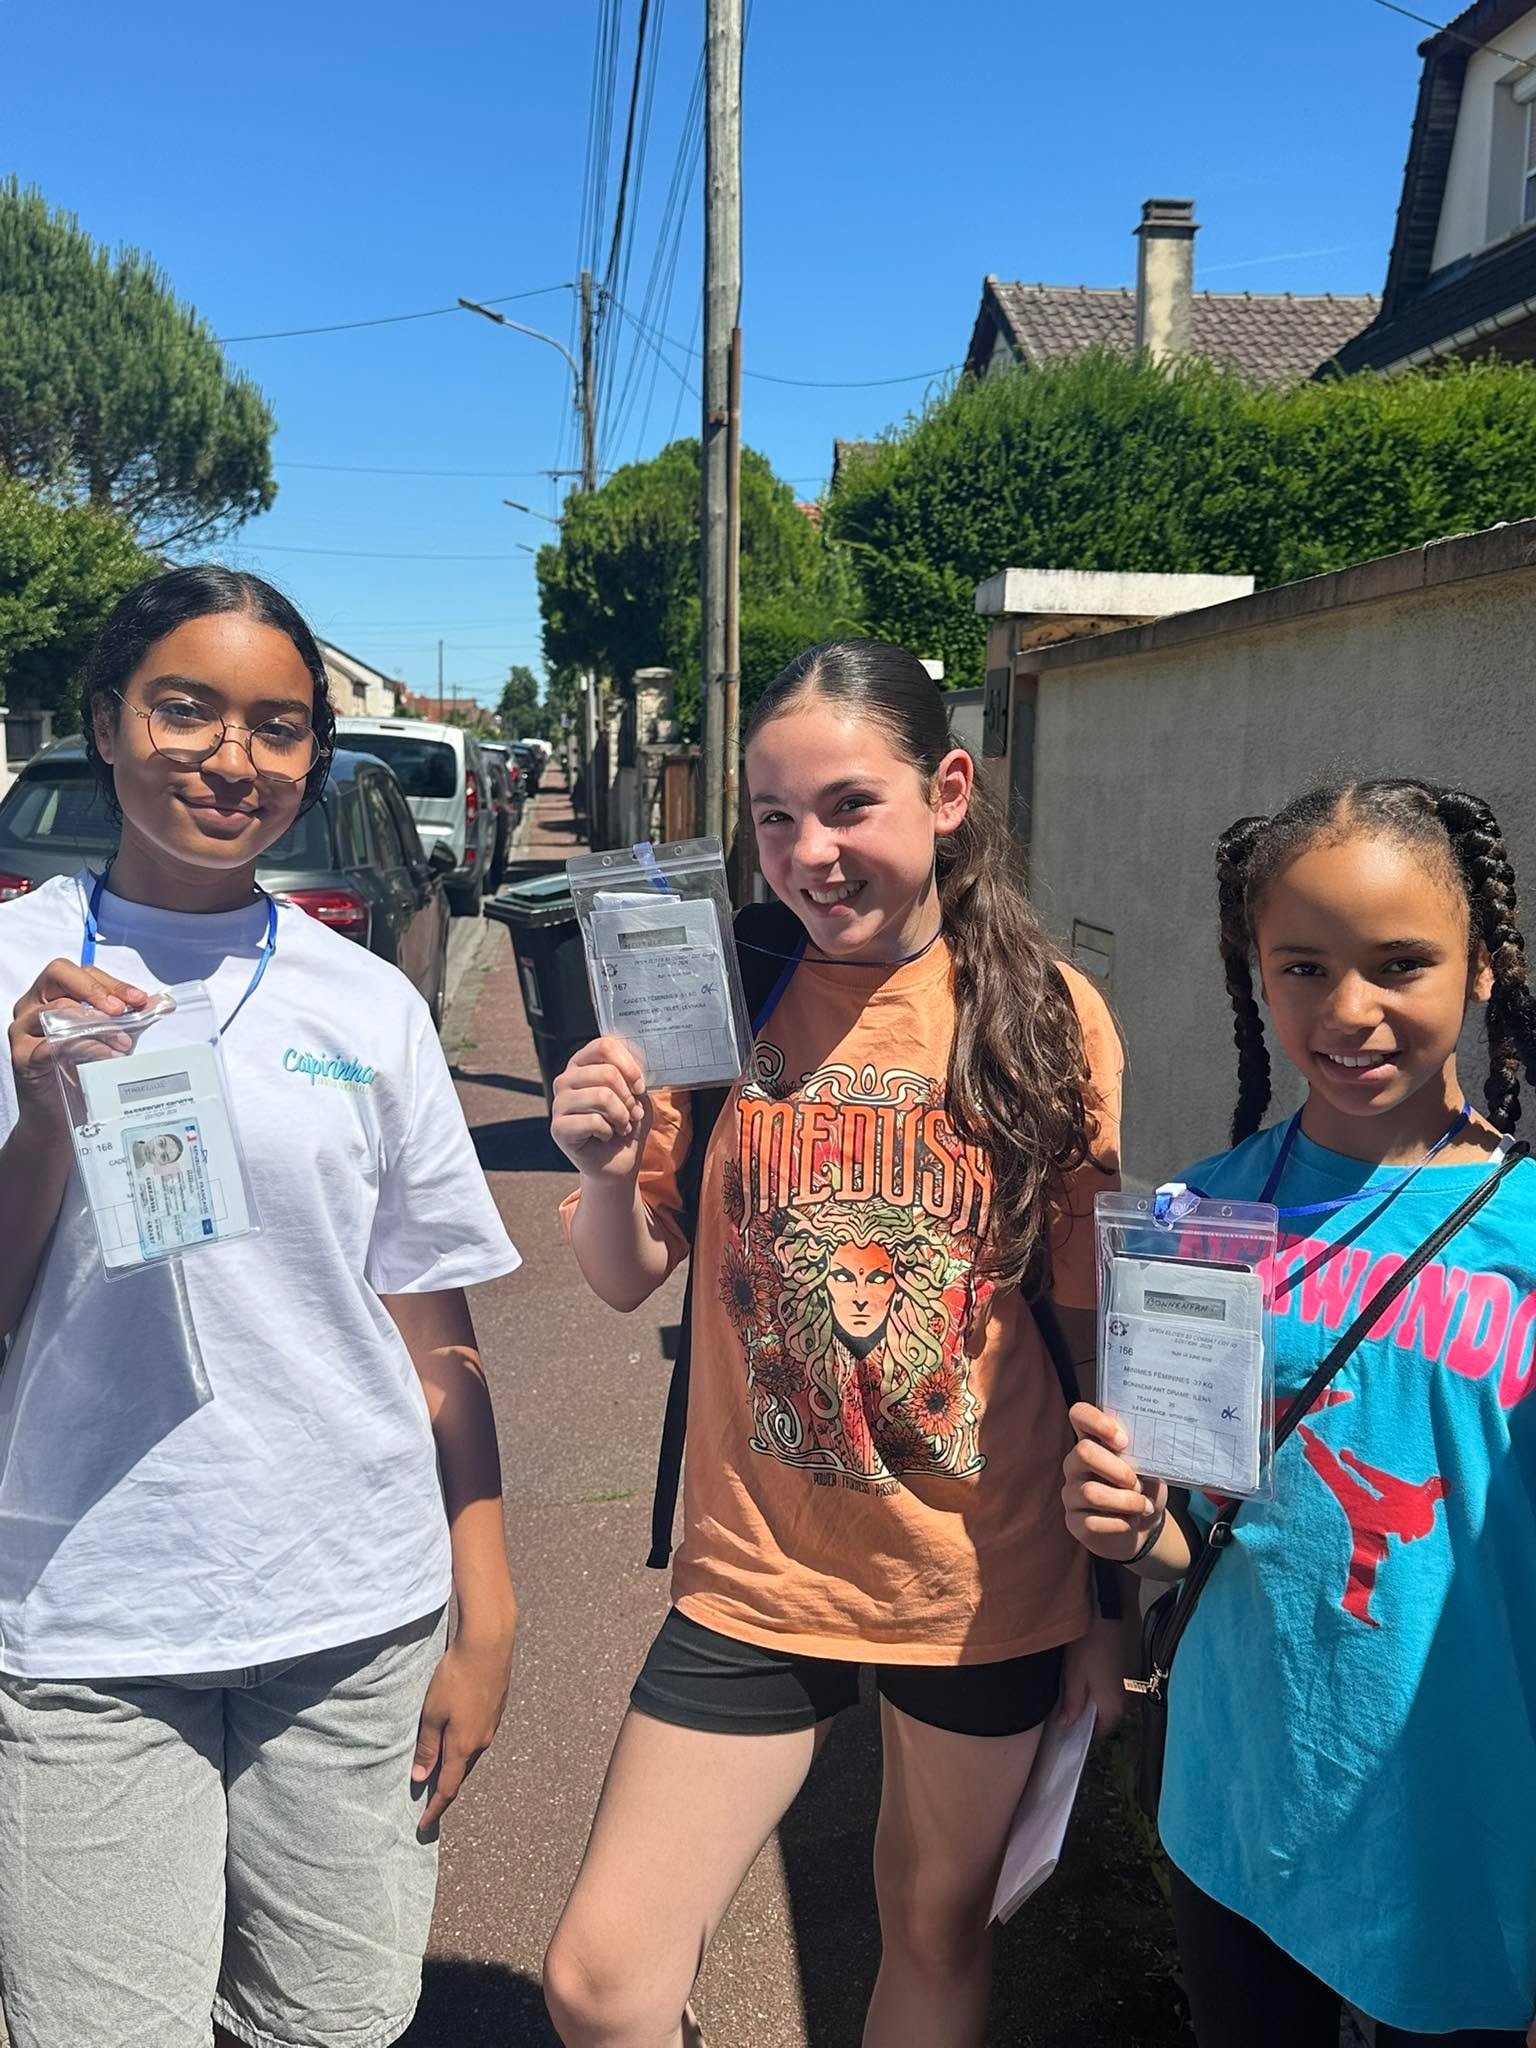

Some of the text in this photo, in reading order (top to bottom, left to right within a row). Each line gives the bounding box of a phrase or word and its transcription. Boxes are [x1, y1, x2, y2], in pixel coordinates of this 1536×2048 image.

[614, 982, 627, 991] 167
[97, 1142, 113, 1152] 168
[1119, 1345, 1134, 1356] 166
